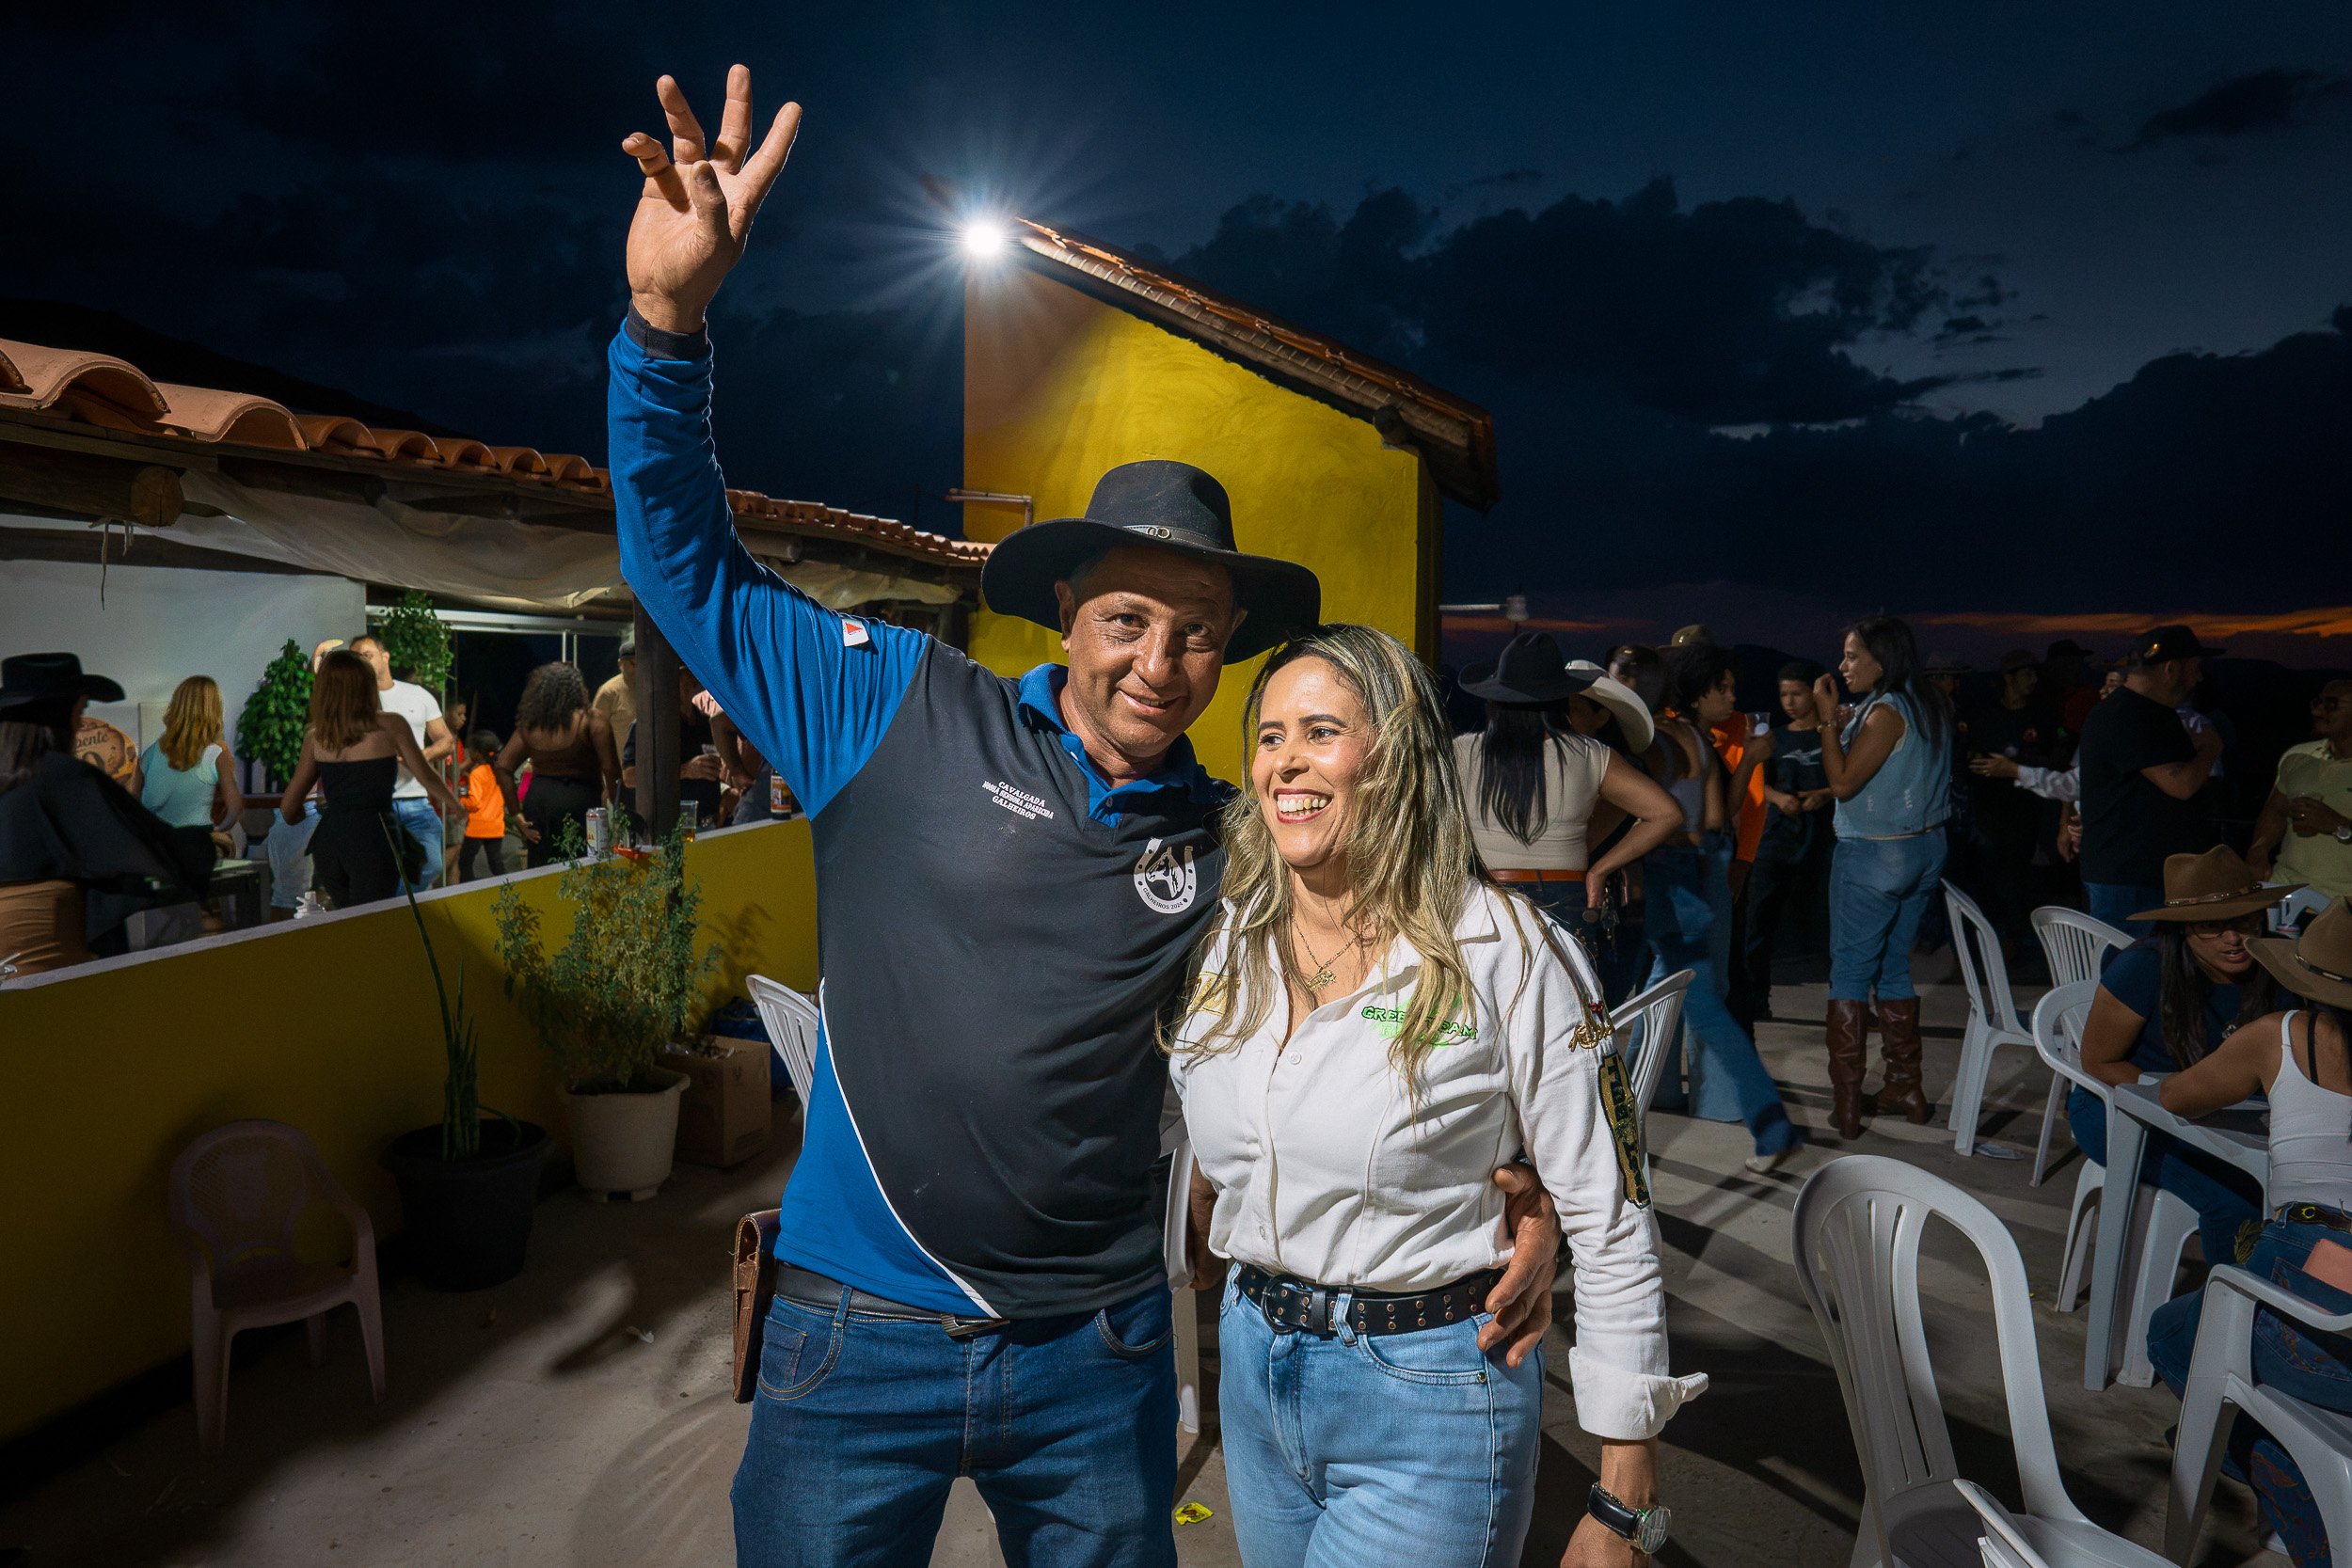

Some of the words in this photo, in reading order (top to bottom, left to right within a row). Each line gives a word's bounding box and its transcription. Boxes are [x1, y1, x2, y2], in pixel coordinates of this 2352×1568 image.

[981, 780, 1001, 795] NOSSA
[999, 789, 1025, 807] SENHORA
[1023, 801, 1055, 820] APARECIDA
[992, 795, 1037, 820] GALHEIROS
[998, 781, 1046, 808] CAVALGADA
[1142, 887, 1170, 910] GALHEIROS
